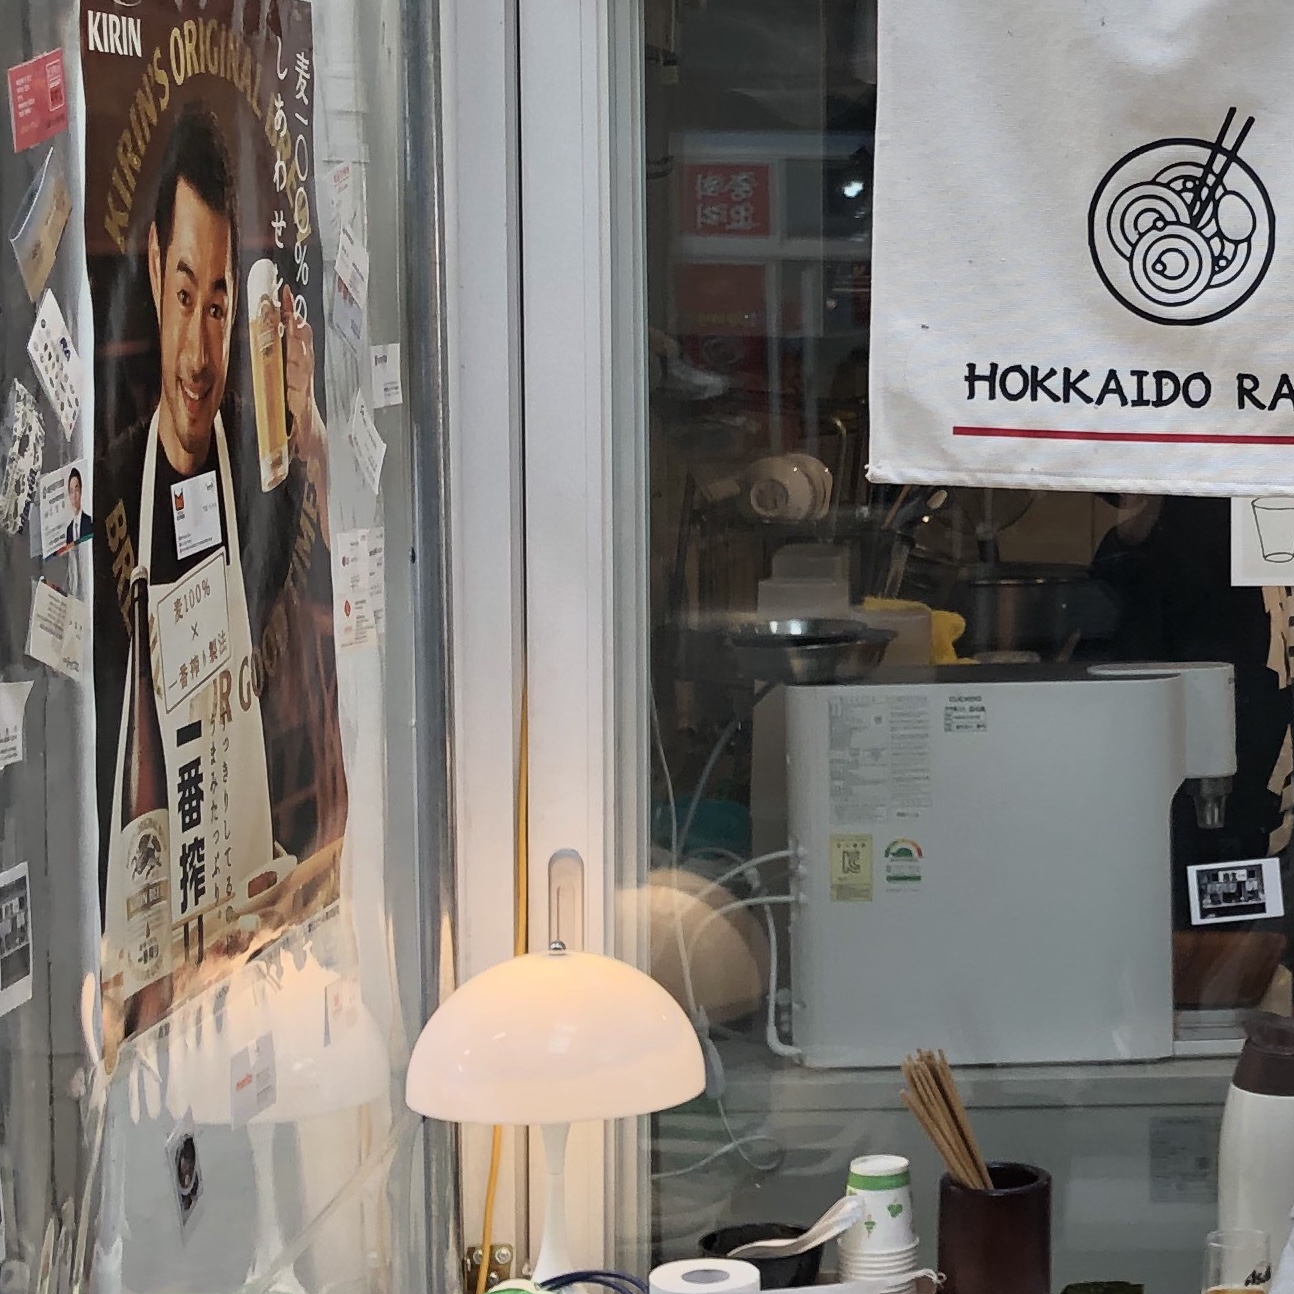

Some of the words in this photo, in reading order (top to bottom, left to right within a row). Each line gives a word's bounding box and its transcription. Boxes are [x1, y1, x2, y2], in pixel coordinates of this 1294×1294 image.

[87, 10, 142, 58] KIRIN
[103, 46, 170, 255] KIRIN'S
[169, 17, 262, 121] ORIGINAL
[963, 362, 1212, 410] HOKKAIDO
[173, 577, 211, 625] 麦100%
[168, 629, 228, 690] 一番搾り製法
